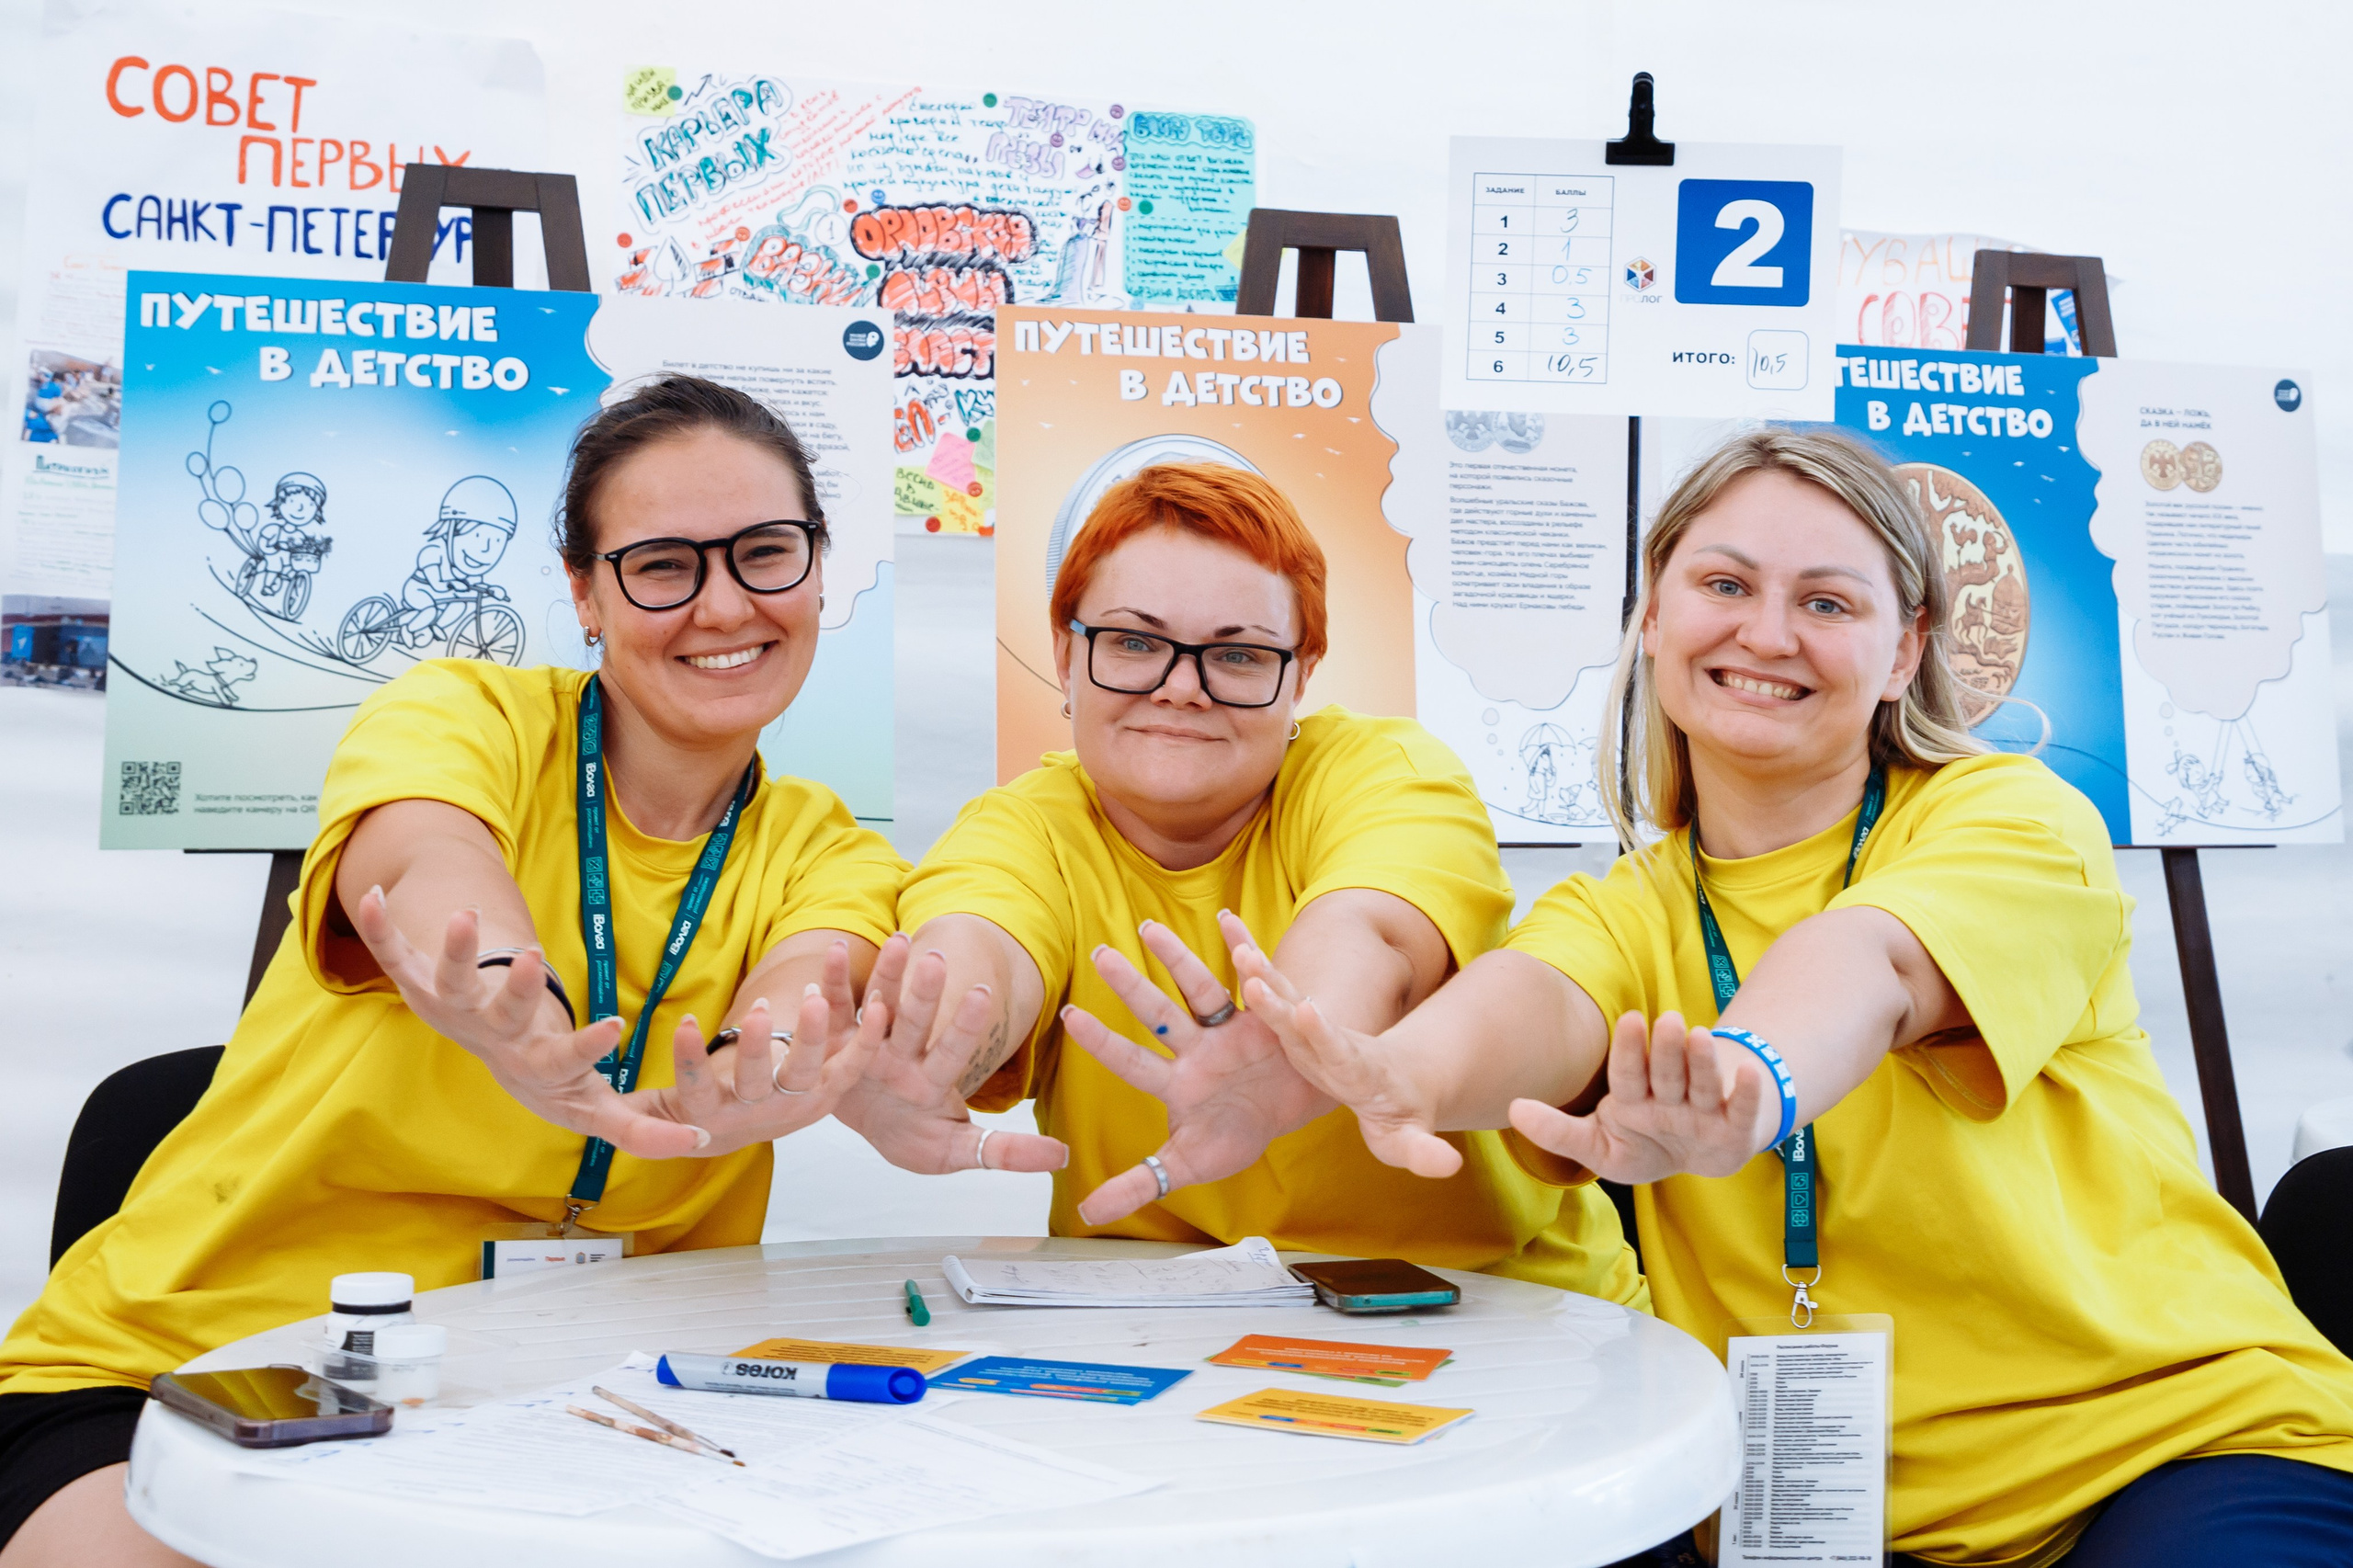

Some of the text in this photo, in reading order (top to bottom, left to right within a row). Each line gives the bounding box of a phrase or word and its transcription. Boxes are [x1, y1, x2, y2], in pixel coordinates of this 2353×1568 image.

[106, 56, 317, 133] СОВЕТ
[642, 79, 783, 172] КАРЬЕРА
[1005, 96, 1092, 137] ТЕАТР
[635, 128, 779, 225] ПЕРВЫХ
[1485, 187, 1586, 197] ЗАДАНИЕ БАЛЛЫ
[102, 193, 473, 264] САНКТ-ПЕТЕРУР
[1500, 208, 1580, 233] 1 3
[1497, 236, 1571, 261] 2 1
[1711, 199, 1785, 289] 2
[1496, 272, 1507, 287] 3
[140, 291, 499, 343] ПУТЕШЕСТВИЕ
[1495, 298, 1586, 319] 4 3
[1015, 320, 1311, 364] ПУТЕШЕСТВИЕ
[1495, 327, 1580, 346] 5 3
[259, 347, 530, 392] В ДЕТСТВО
[1493, 360, 1504, 374] 6
[1672, 351, 1736, 365] ИТОГО:
[1836, 356, 2026, 396] ТЕШЕСТВИЕ
[1120, 369, 1343, 409] В ДЕТСТВО
[1867, 400, 2053, 439] В ДЕТСТВО
[585, 762, 597, 798] iВолга
[593, 914, 606, 949] iВолга
